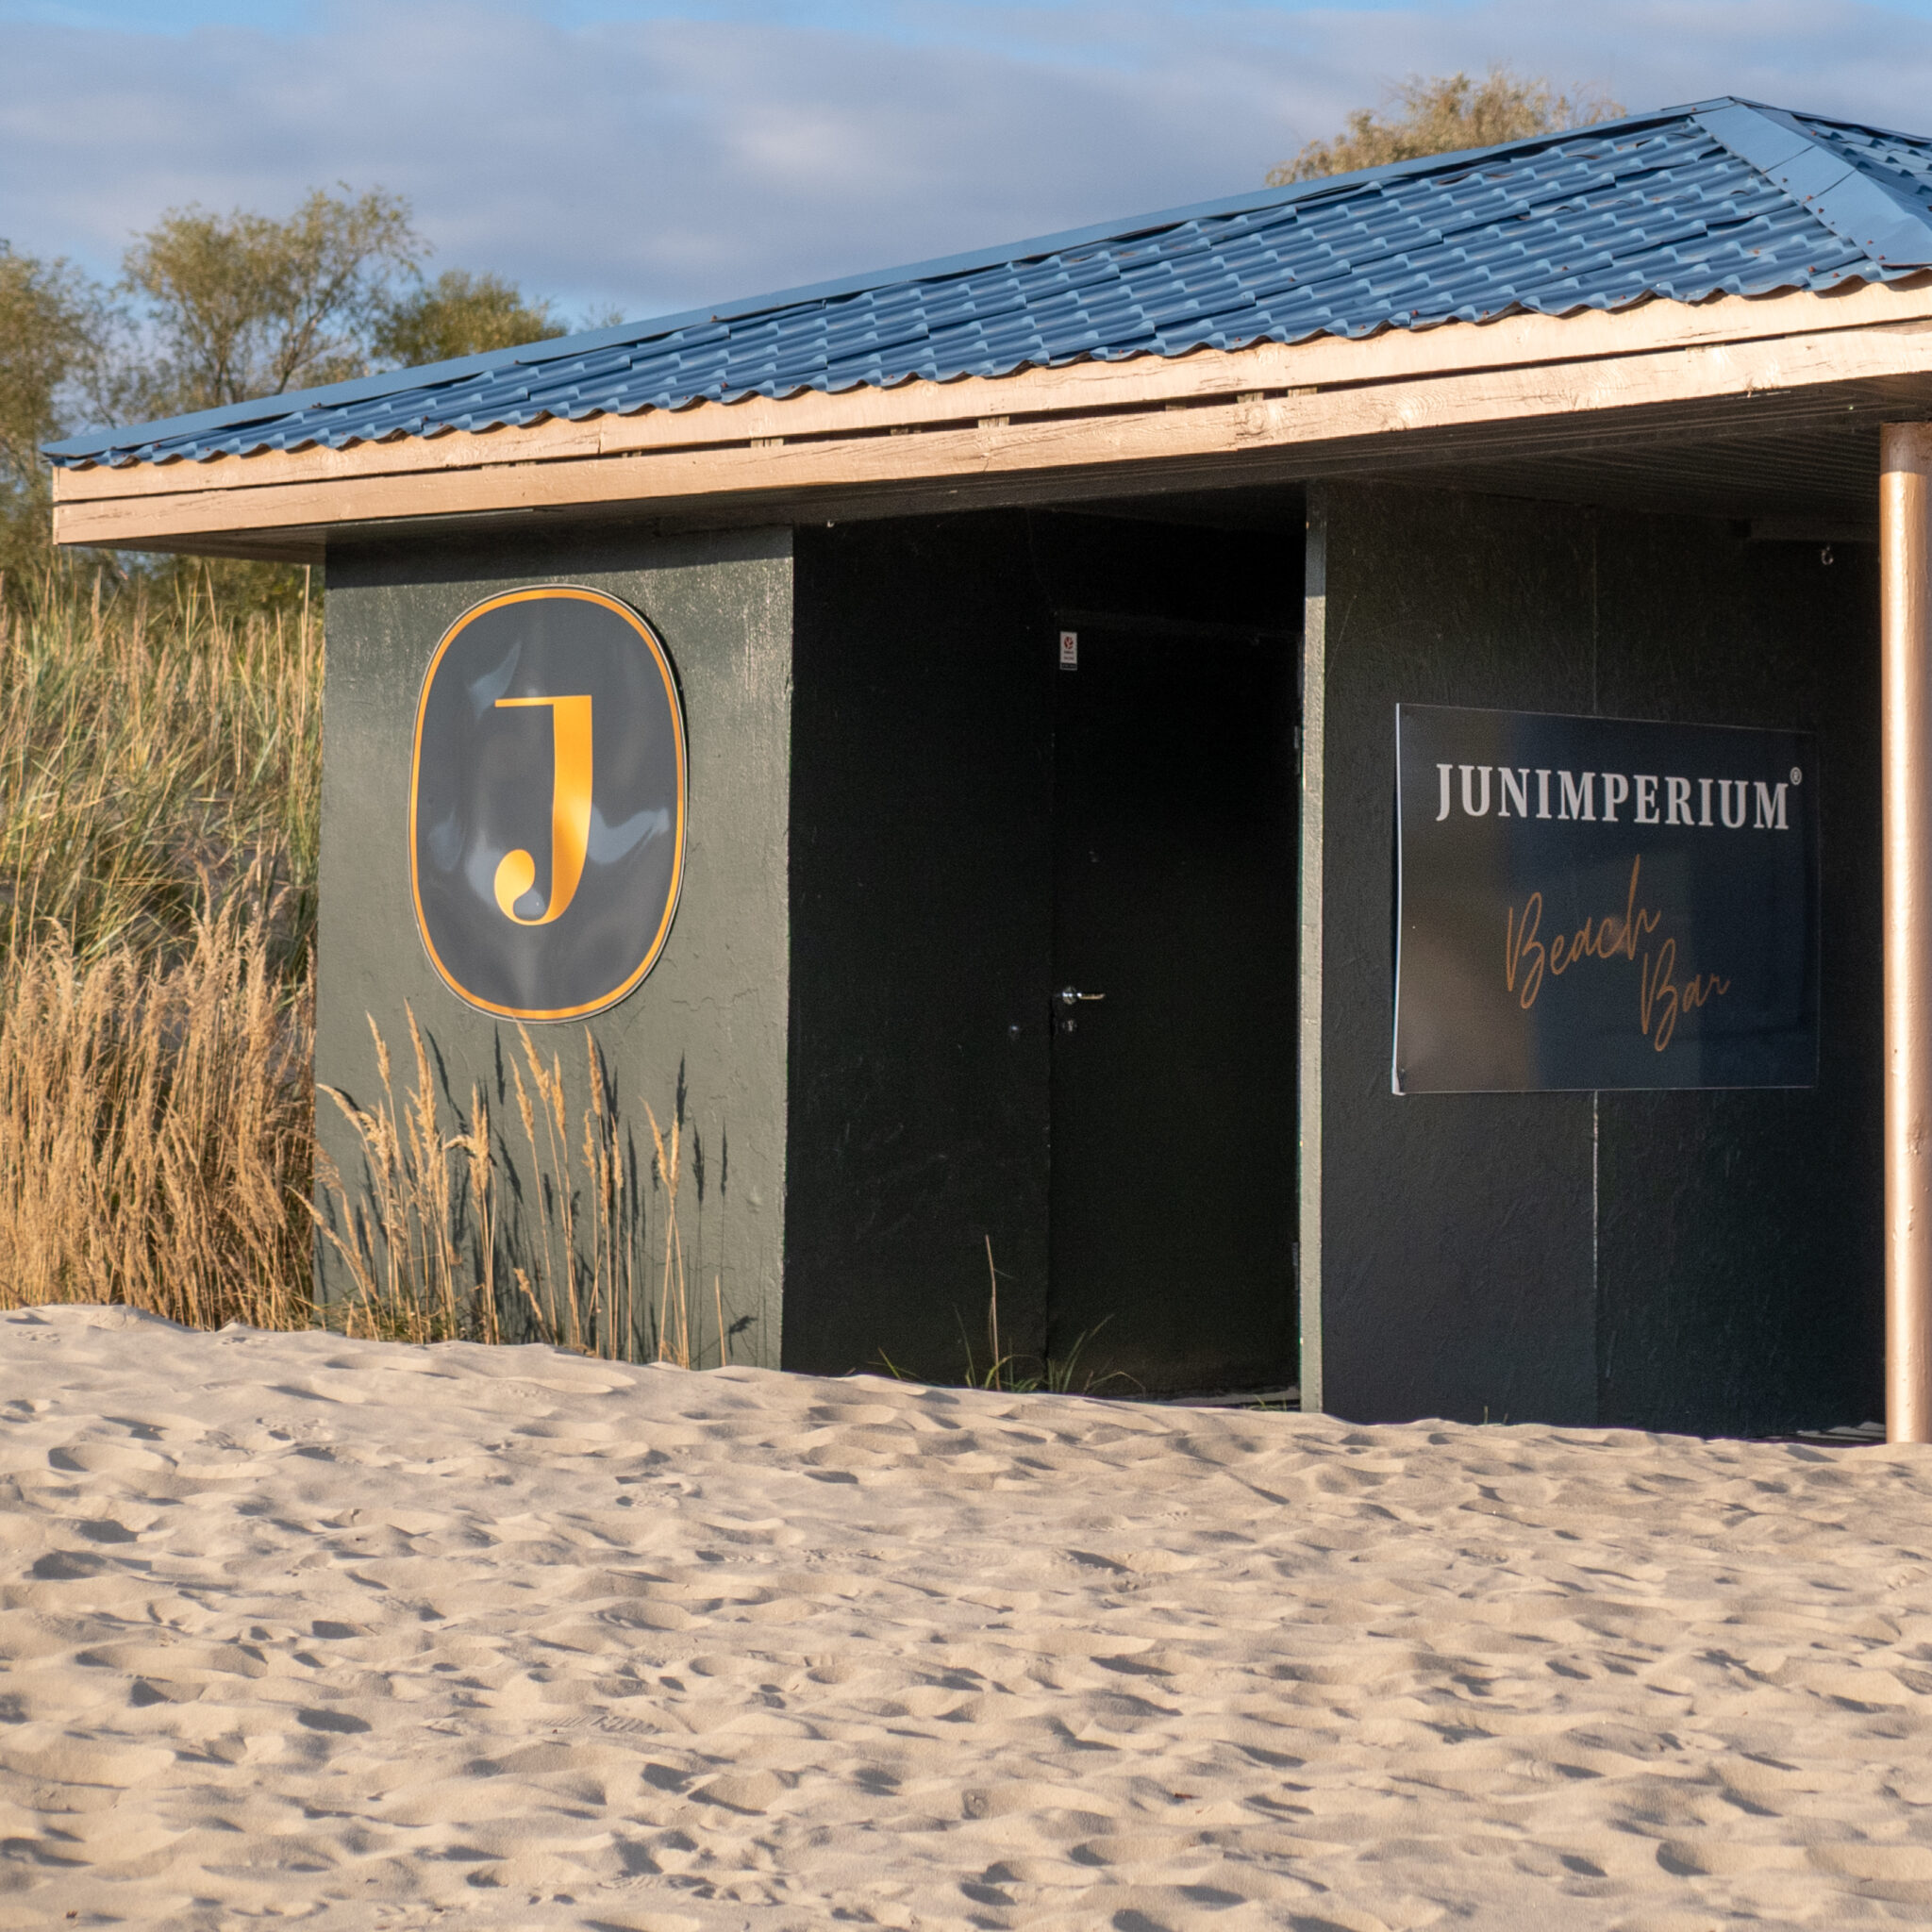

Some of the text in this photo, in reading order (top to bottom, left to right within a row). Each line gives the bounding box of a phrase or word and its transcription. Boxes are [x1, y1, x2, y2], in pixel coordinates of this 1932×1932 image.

[494, 694, 593, 926] J
[1507, 854, 1662, 1009] Beach
[1641, 939, 1730, 1052] Bar
